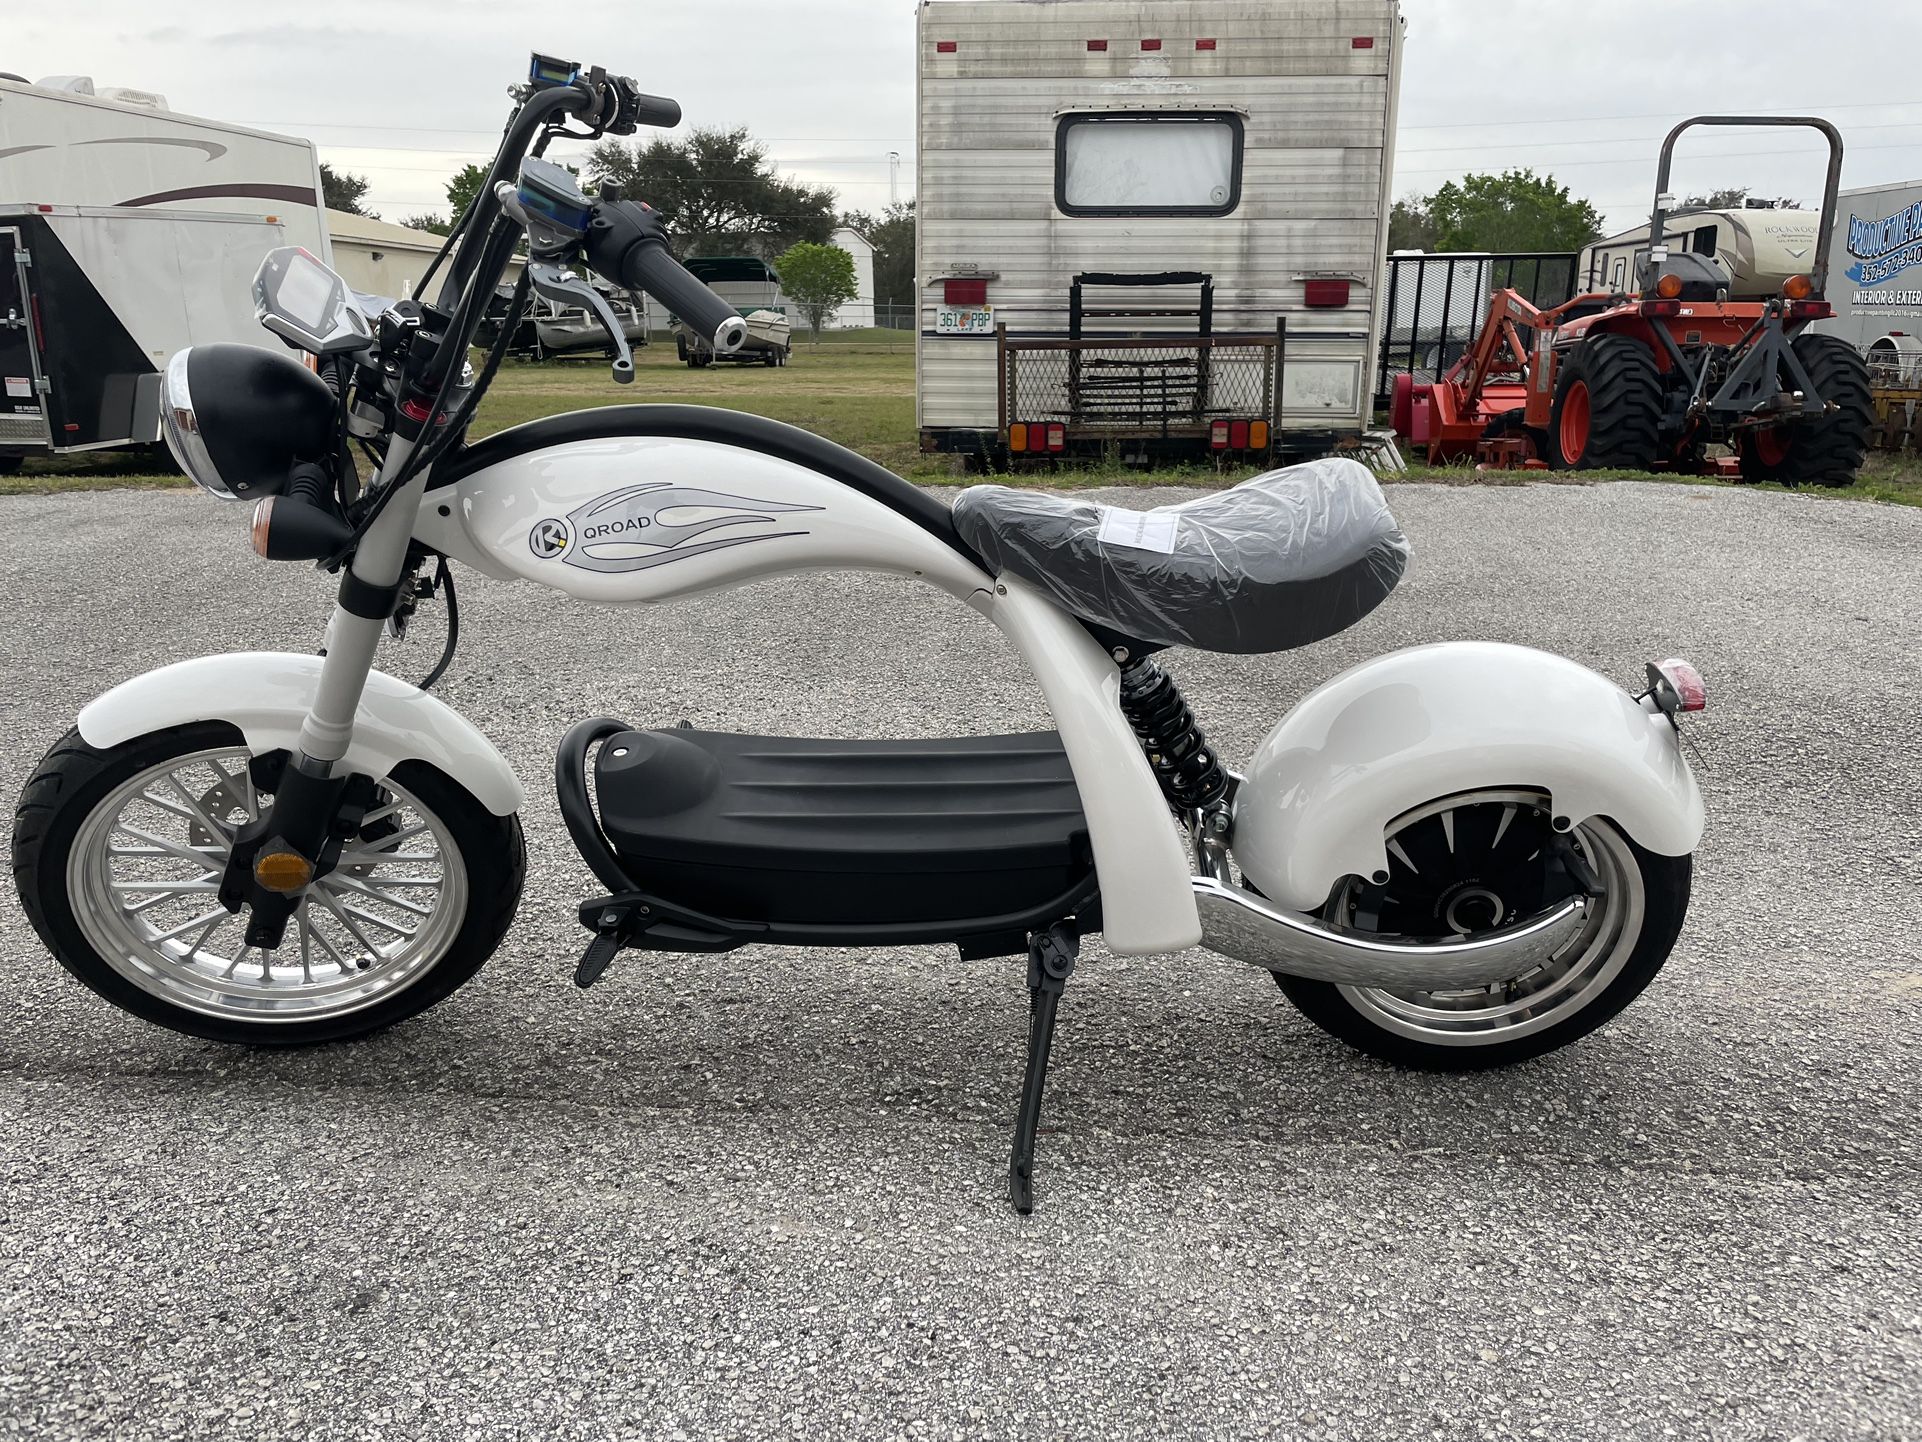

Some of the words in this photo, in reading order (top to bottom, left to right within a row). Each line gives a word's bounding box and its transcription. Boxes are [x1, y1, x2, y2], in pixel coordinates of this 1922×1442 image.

[1847, 206, 1912, 259] PRODUCTIVE
[1852, 290, 1887, 305] INTERIOR
[1887, 290, 1894, 305] &
[1895, 290, 1922, 306] EXTER
[940, 313, 958, 327] 361
[971, 313, 990, 327] PBP
[584, 516, 651, 539] QROAD
